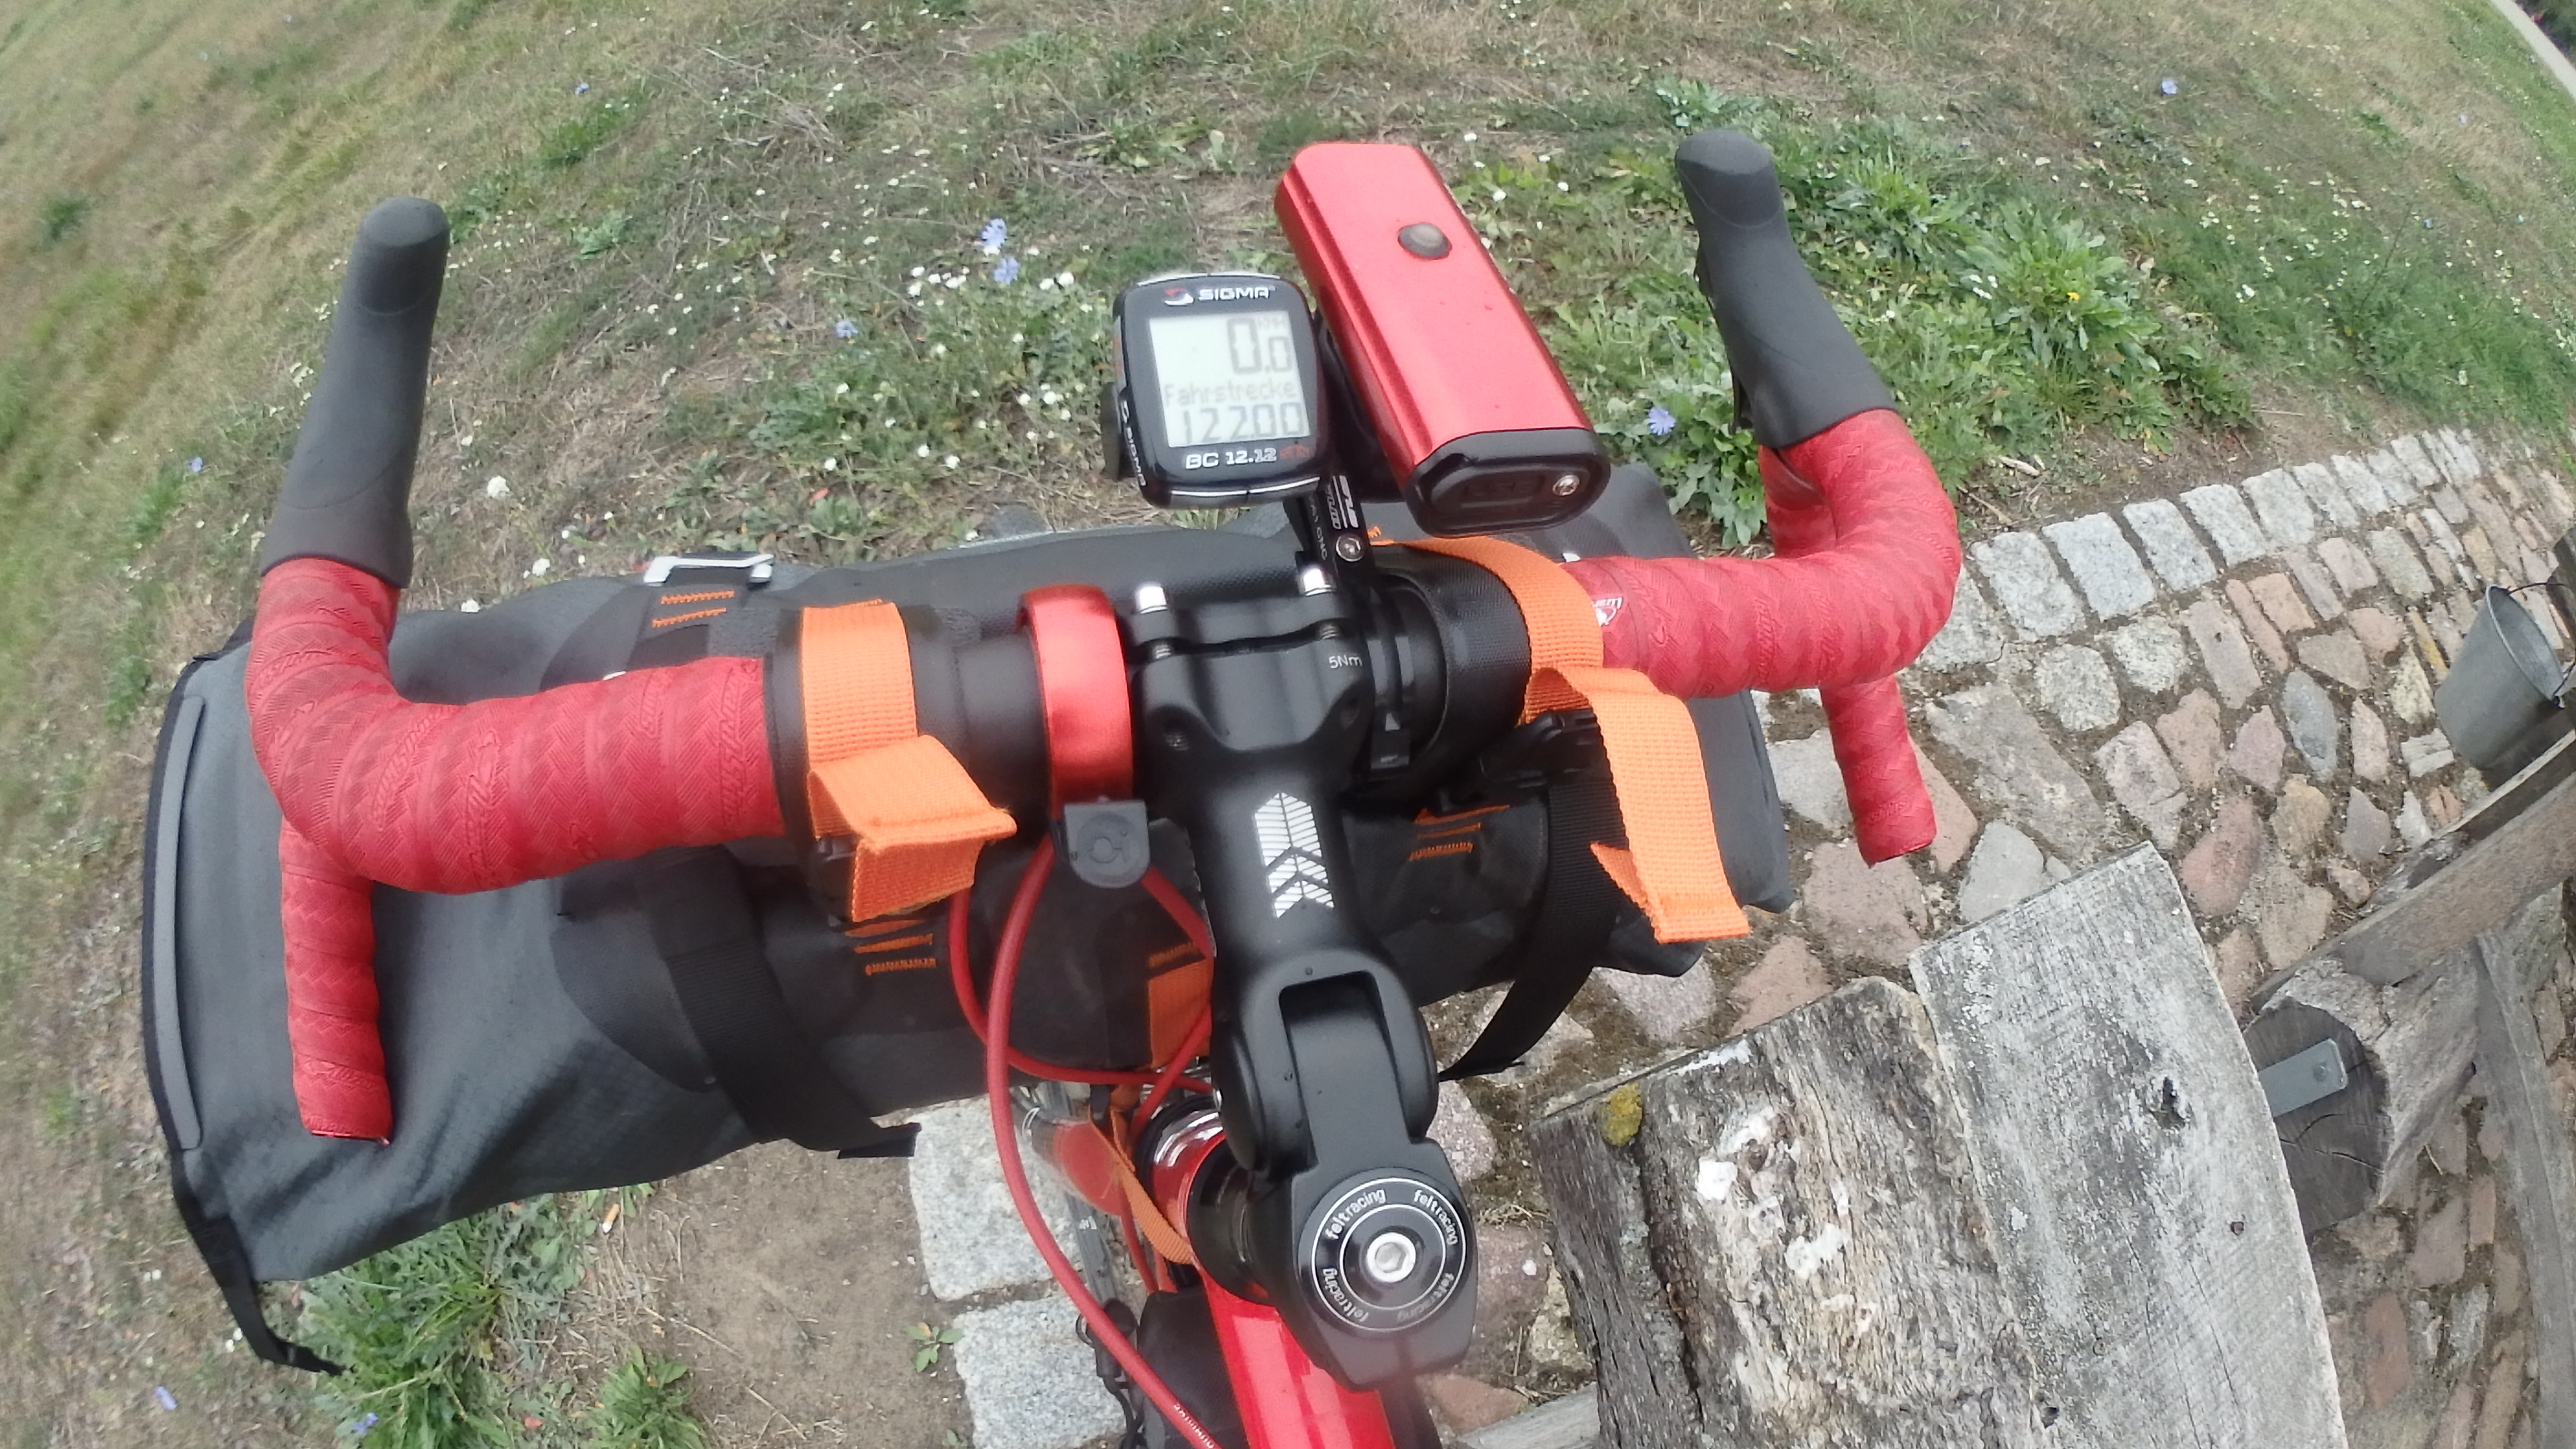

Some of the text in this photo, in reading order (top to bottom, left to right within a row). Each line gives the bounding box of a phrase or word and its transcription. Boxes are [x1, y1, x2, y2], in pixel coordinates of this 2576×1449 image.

[1197, 286, 1270, 301] SIGMA
[1163, 378, 1297, 407] Fahrstrecke
[1185, 452, 1220, 470] BC
[1225, 447, 1277, 465] 12.12
[1328, 654, 1362, 669] 5Nm
[1325, 1189, 1387, 1240] feltracing
[1413, 1189, 1458, 1245] feltracing
[1322, 1268, 1369, 1322] feltracing
